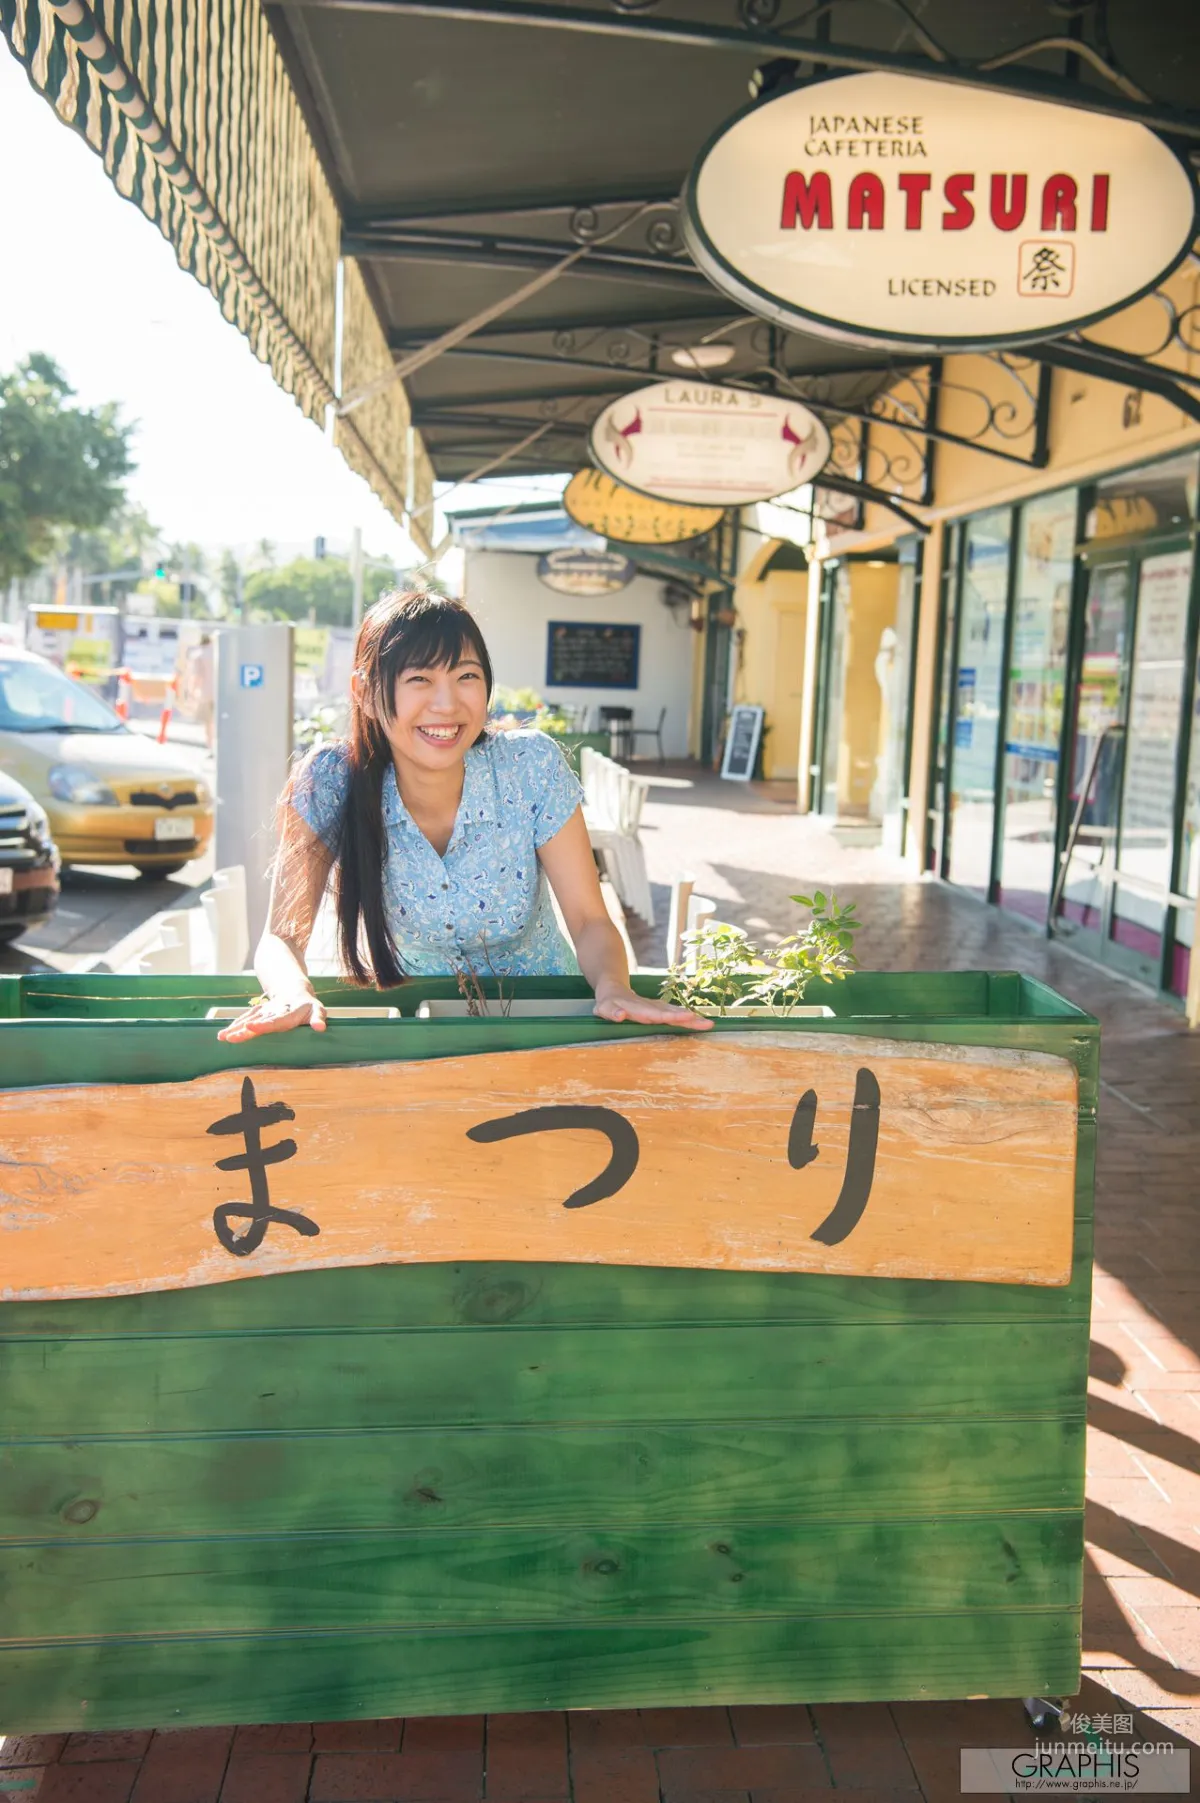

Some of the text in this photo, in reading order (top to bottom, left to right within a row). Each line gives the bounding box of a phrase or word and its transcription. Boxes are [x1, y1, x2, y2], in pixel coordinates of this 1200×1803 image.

[810, 115, 924, 136] JAPANESE
[805, 138, 928, 158] CAFETERIA
[779, 170, 1110, 232] MATSURI
[1023, 246, 1067, 292] 祭
[888, 278, 997, 297] LICENSED
[664, 387, 763, 409] LAURAS
[244, 666, 261, 687] P
[206, 1067, 882, 1257] まつり
